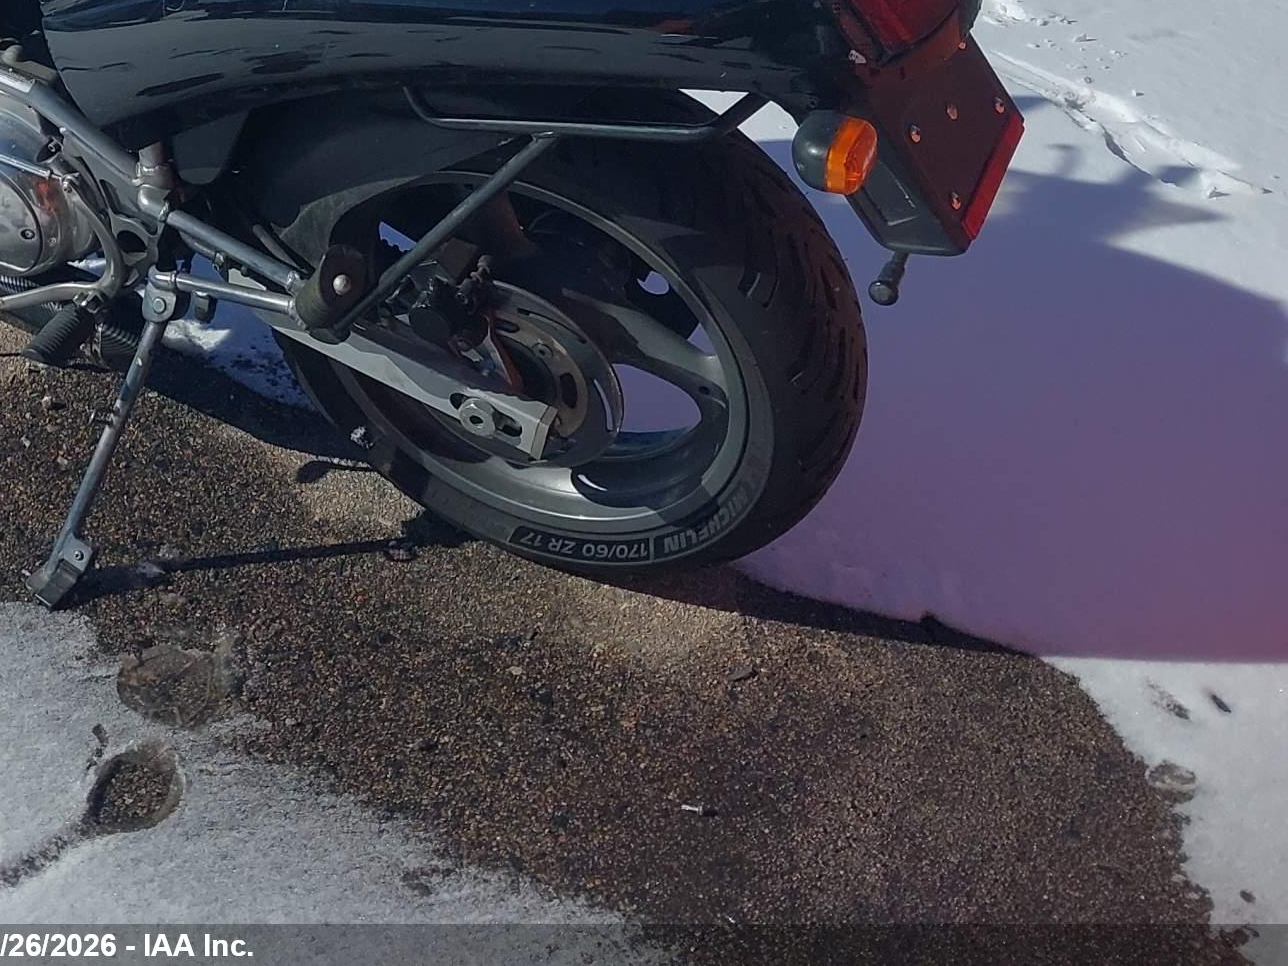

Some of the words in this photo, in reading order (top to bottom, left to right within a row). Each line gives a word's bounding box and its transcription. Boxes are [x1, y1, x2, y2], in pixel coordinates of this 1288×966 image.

[662, 487, 750, 554] MICHELIN
[520, 532, 543, 548] 17
[548, 538, 574, 555] ZR
[582, 542, 648, 560] 170/60
